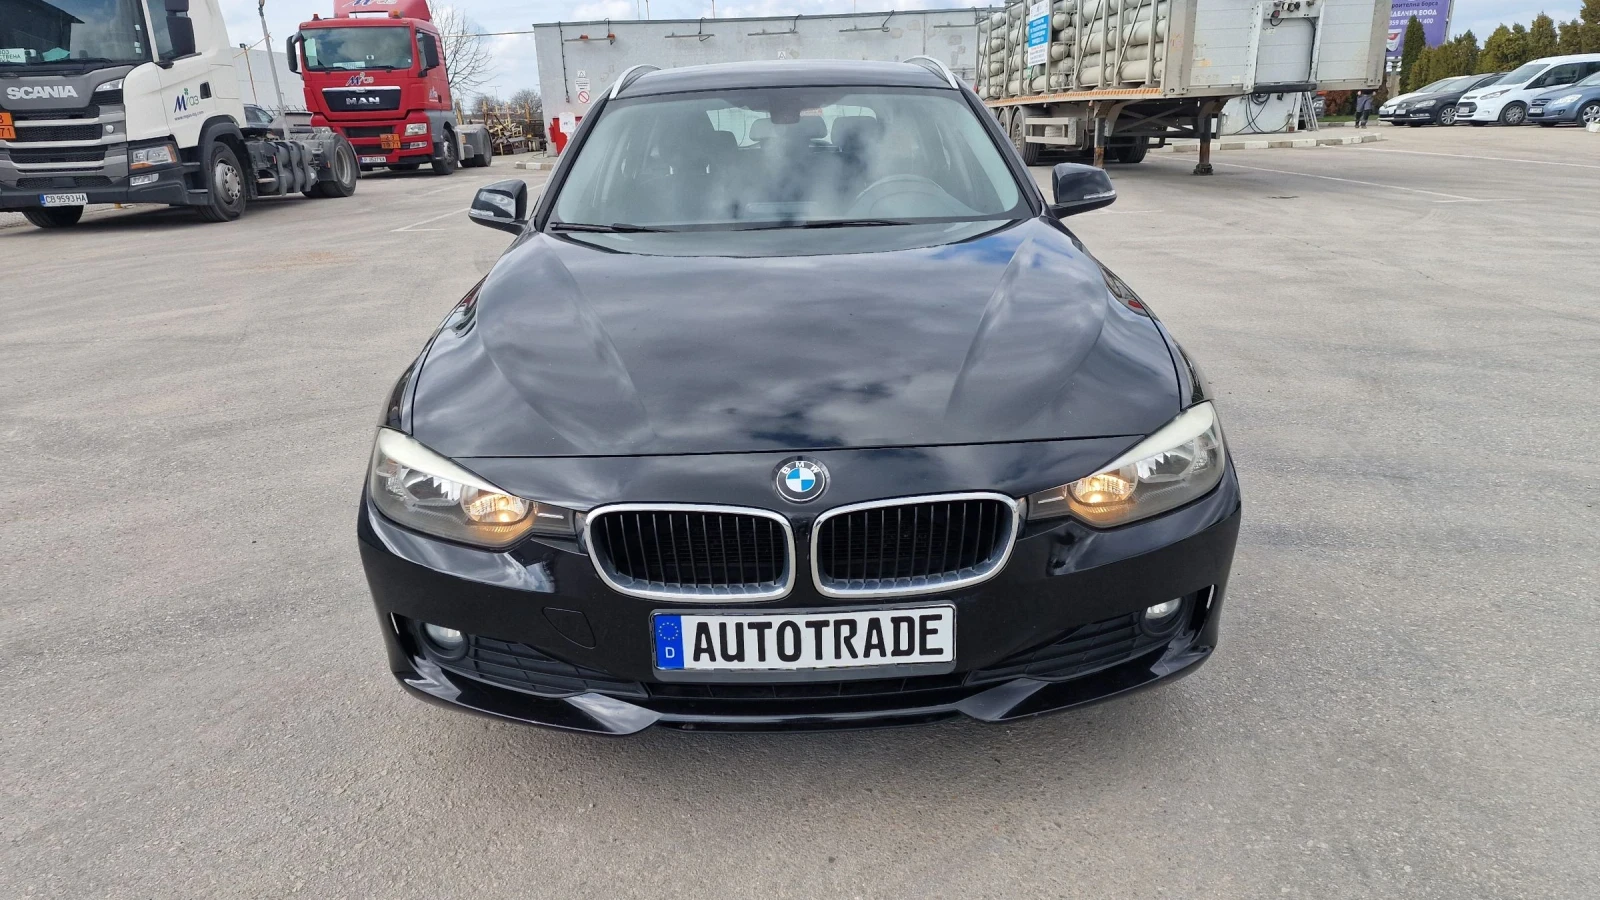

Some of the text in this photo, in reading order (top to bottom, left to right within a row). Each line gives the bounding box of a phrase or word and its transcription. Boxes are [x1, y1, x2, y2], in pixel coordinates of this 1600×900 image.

[6, 85, 79, 100] SCANIA
[345, 97, 380, 105] MAN
[780, 461, 820, 474] BMW
[692, 613, 944, 664] AUTOTRADE
[665, 647, 675, 659] D
